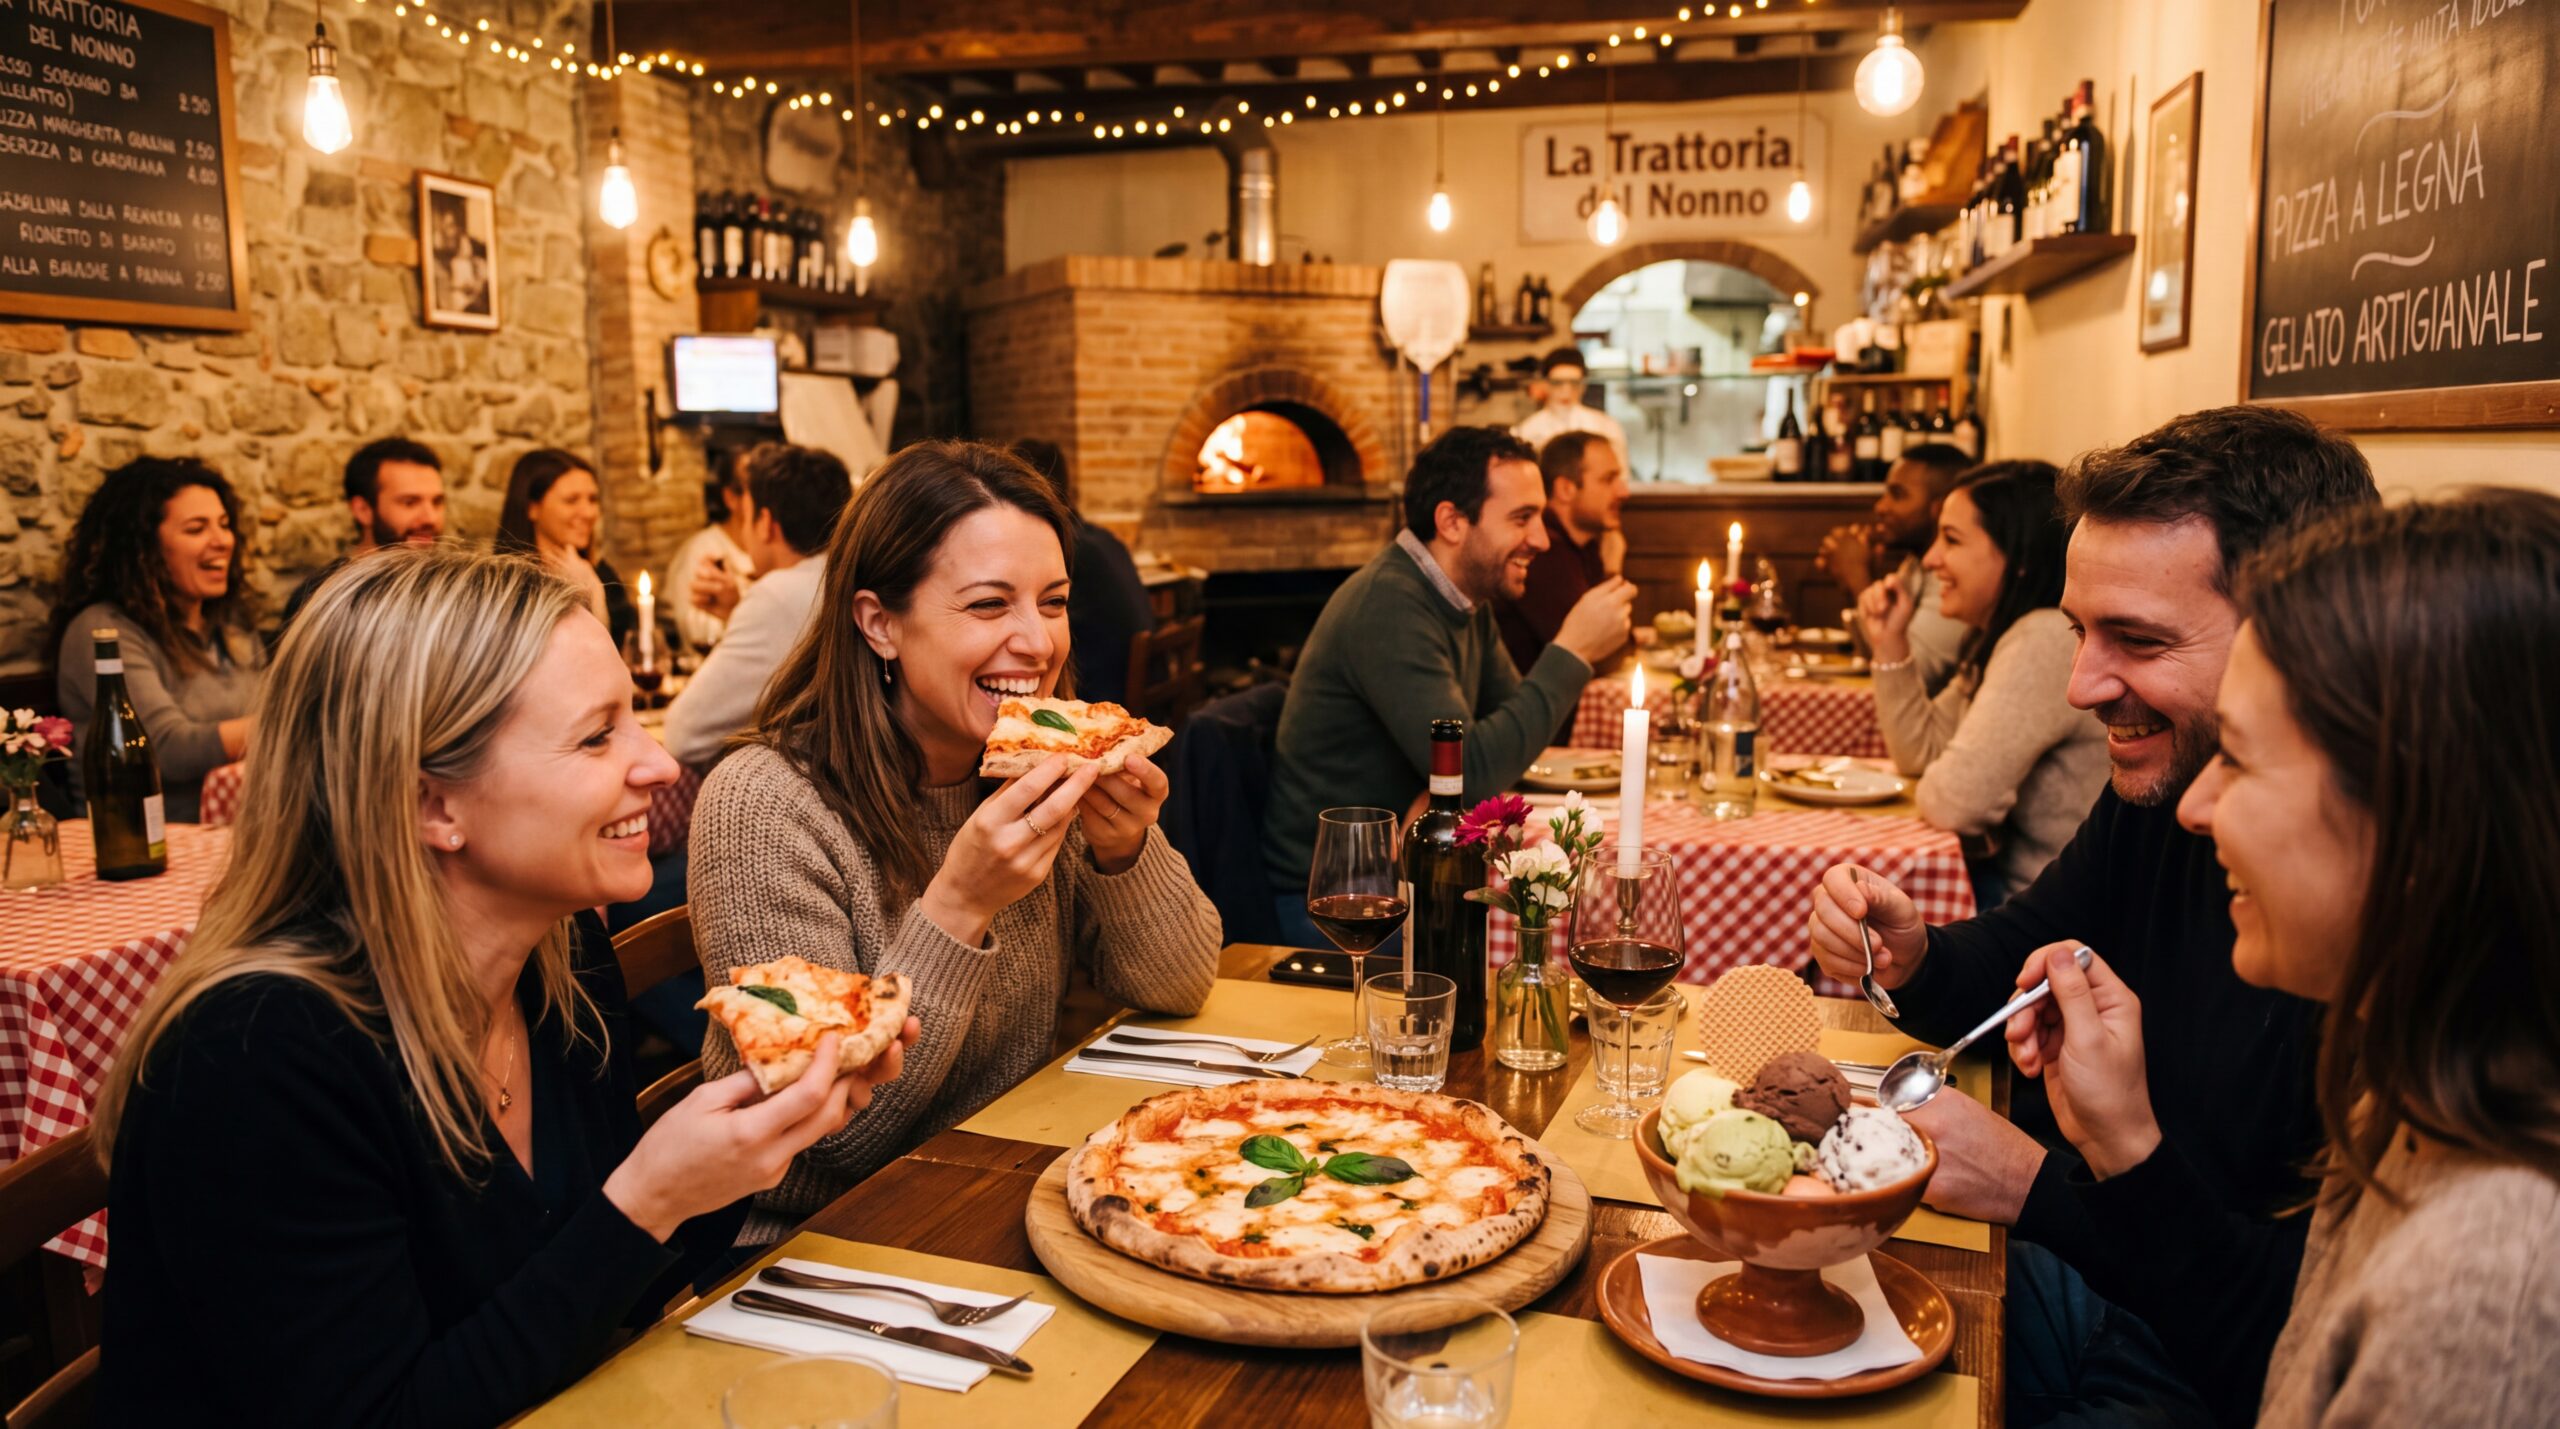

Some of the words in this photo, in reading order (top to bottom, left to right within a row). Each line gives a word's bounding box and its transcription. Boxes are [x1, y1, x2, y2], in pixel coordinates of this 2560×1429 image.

[29, 24, 62, 50] DEL
[71, 33, 136, 69] NONNO
[1546, 136, 1592, 177] La
[1608, 127, 1792, 174] Trattoria
[1577, 184, 1632, 220] dl
[1648, 182, 1770, 218] Nonno
[2272, 176, 2339, 261] PIZZA
[2350, 180, 2365, 234] A
[2377, 121, 2484, 225] LEGNA
[2261, 307, 2345, 377] GELATO
[2352, 258, 2546, 364] ARTIGIANALE
